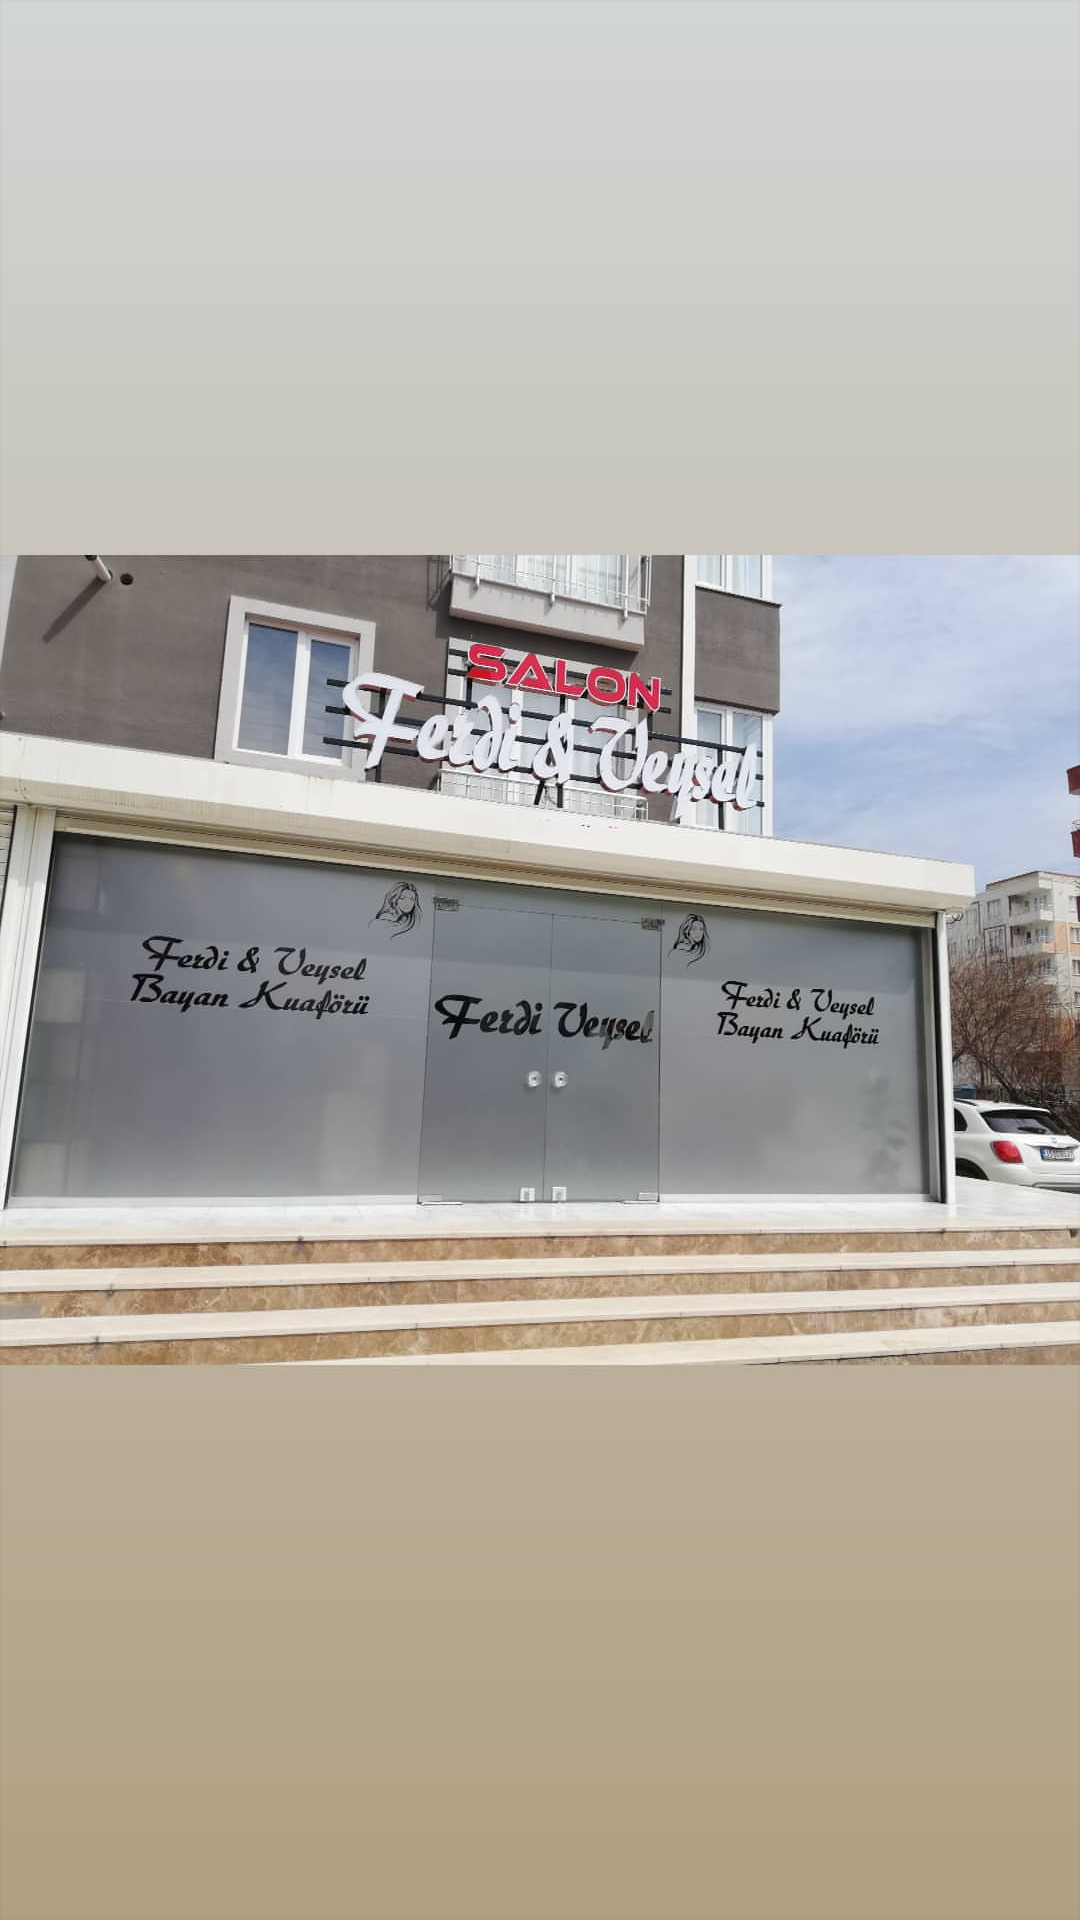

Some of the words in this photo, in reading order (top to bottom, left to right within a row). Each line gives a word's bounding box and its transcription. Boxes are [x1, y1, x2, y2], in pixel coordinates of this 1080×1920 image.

[467, 642, 661, 712] SALON
[342, 673, 521, 773] Ferdi
[533, 711, 573, 785] &
[589, 716, 764, 821] Veysel
[142, 936, 230, 971] Ferdi
[237, 946, 260, 973] &
[274, 946, 367, 984] Veysel
[130, 973, 229, 1012] Bayan
[239, 980, 370, 1019] Kuaförü
[721, 980, 781, 1010] Ferdi
[786, 988, 802, 1010] &
[811, 988, 875, 1020] Veysel
[434, 994, 543, 1039] Ferdi
[553, 1001, 655, 1050] Veysel
[717, 1011, 784, 1044] Bayan
[790, 1016, 880, 1049] Kuaförü
